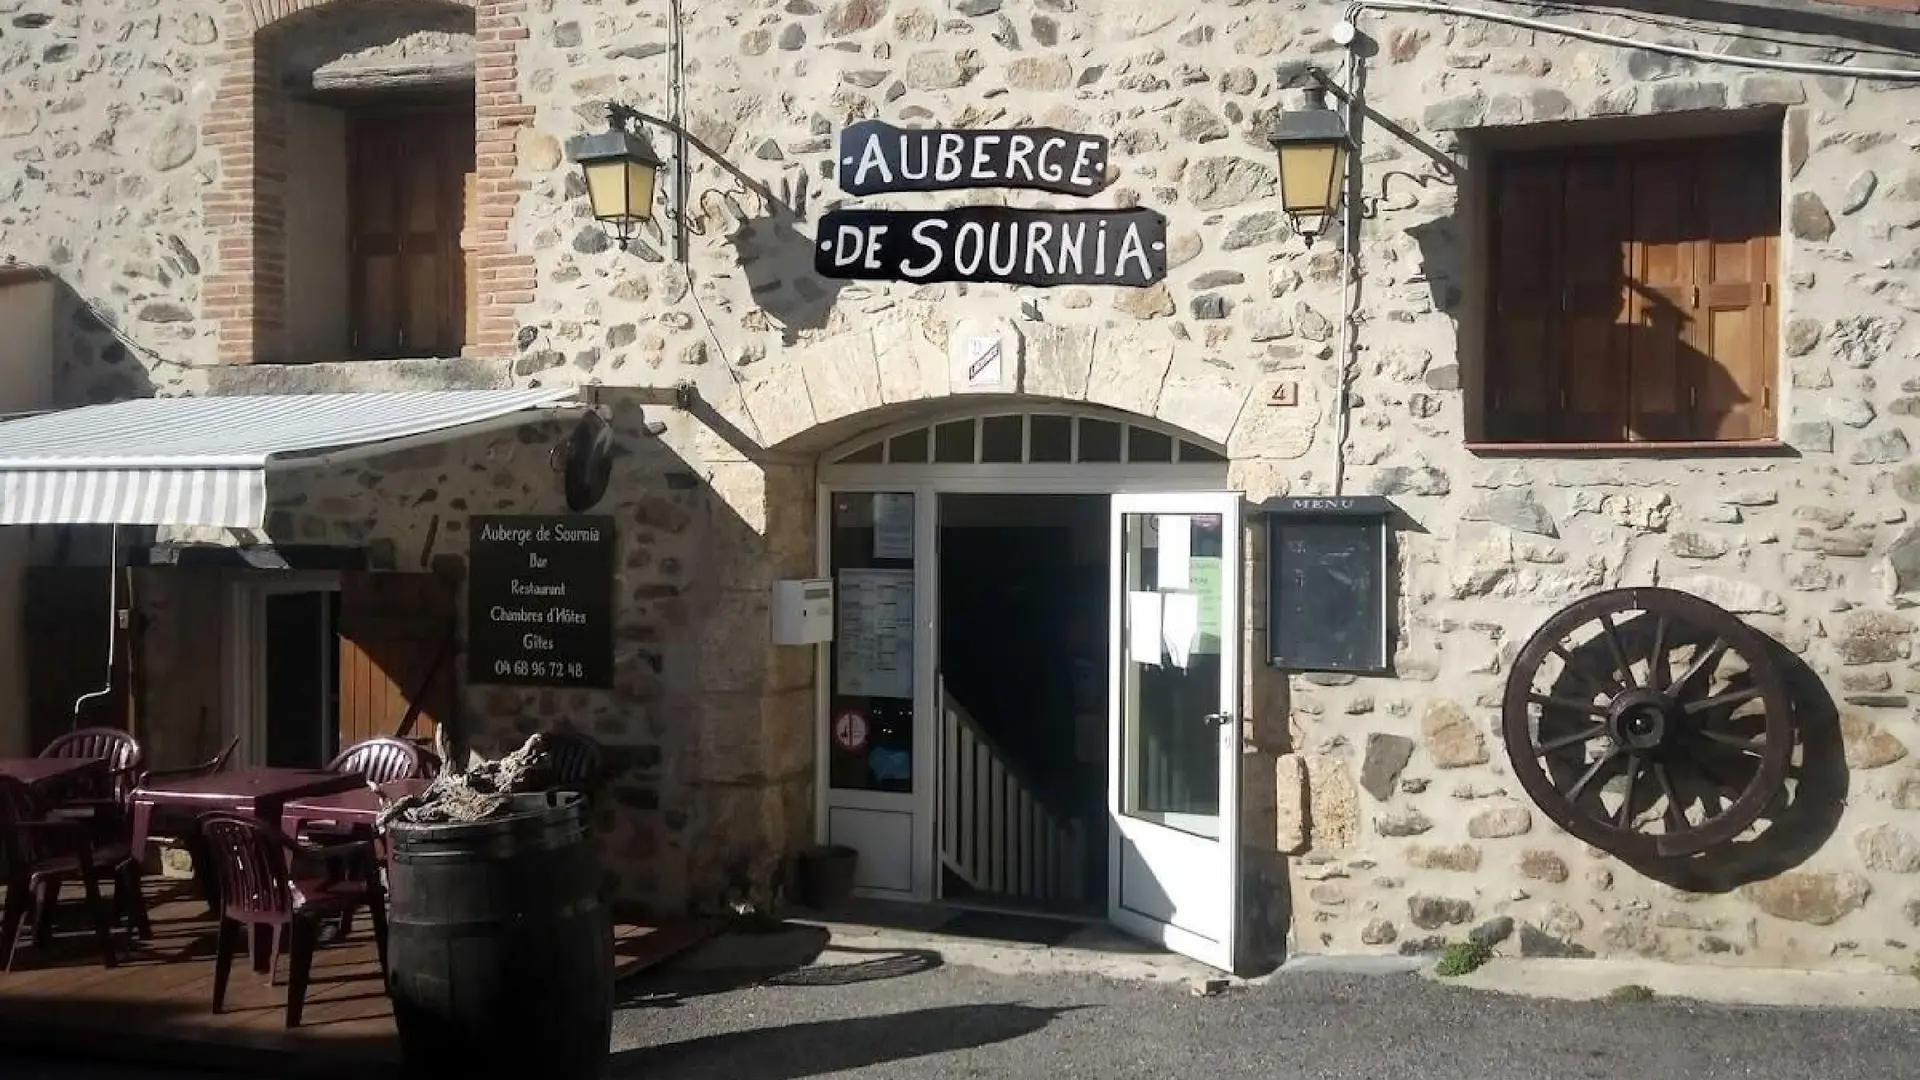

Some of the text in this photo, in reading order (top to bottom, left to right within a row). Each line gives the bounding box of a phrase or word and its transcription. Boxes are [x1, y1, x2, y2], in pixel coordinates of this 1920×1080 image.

[853, 133, 1102, 187] AUBERGE
[834, 225, 888, 269] DE
[1271, 382, 1287, 401] 4
[1292, 499, 1354, 510] MENU
[480, 523, 601, 547] Auberge de Sournia
[529, 552, 548, 568] Bar
[511, 579, 566, 596] Restaurant
[490, 605, 587, 624] Chambres d'Hôtes
[522, 633, 554, 650] Gîtes
[494, 660, 583, 679] 04 68 96 72 48
